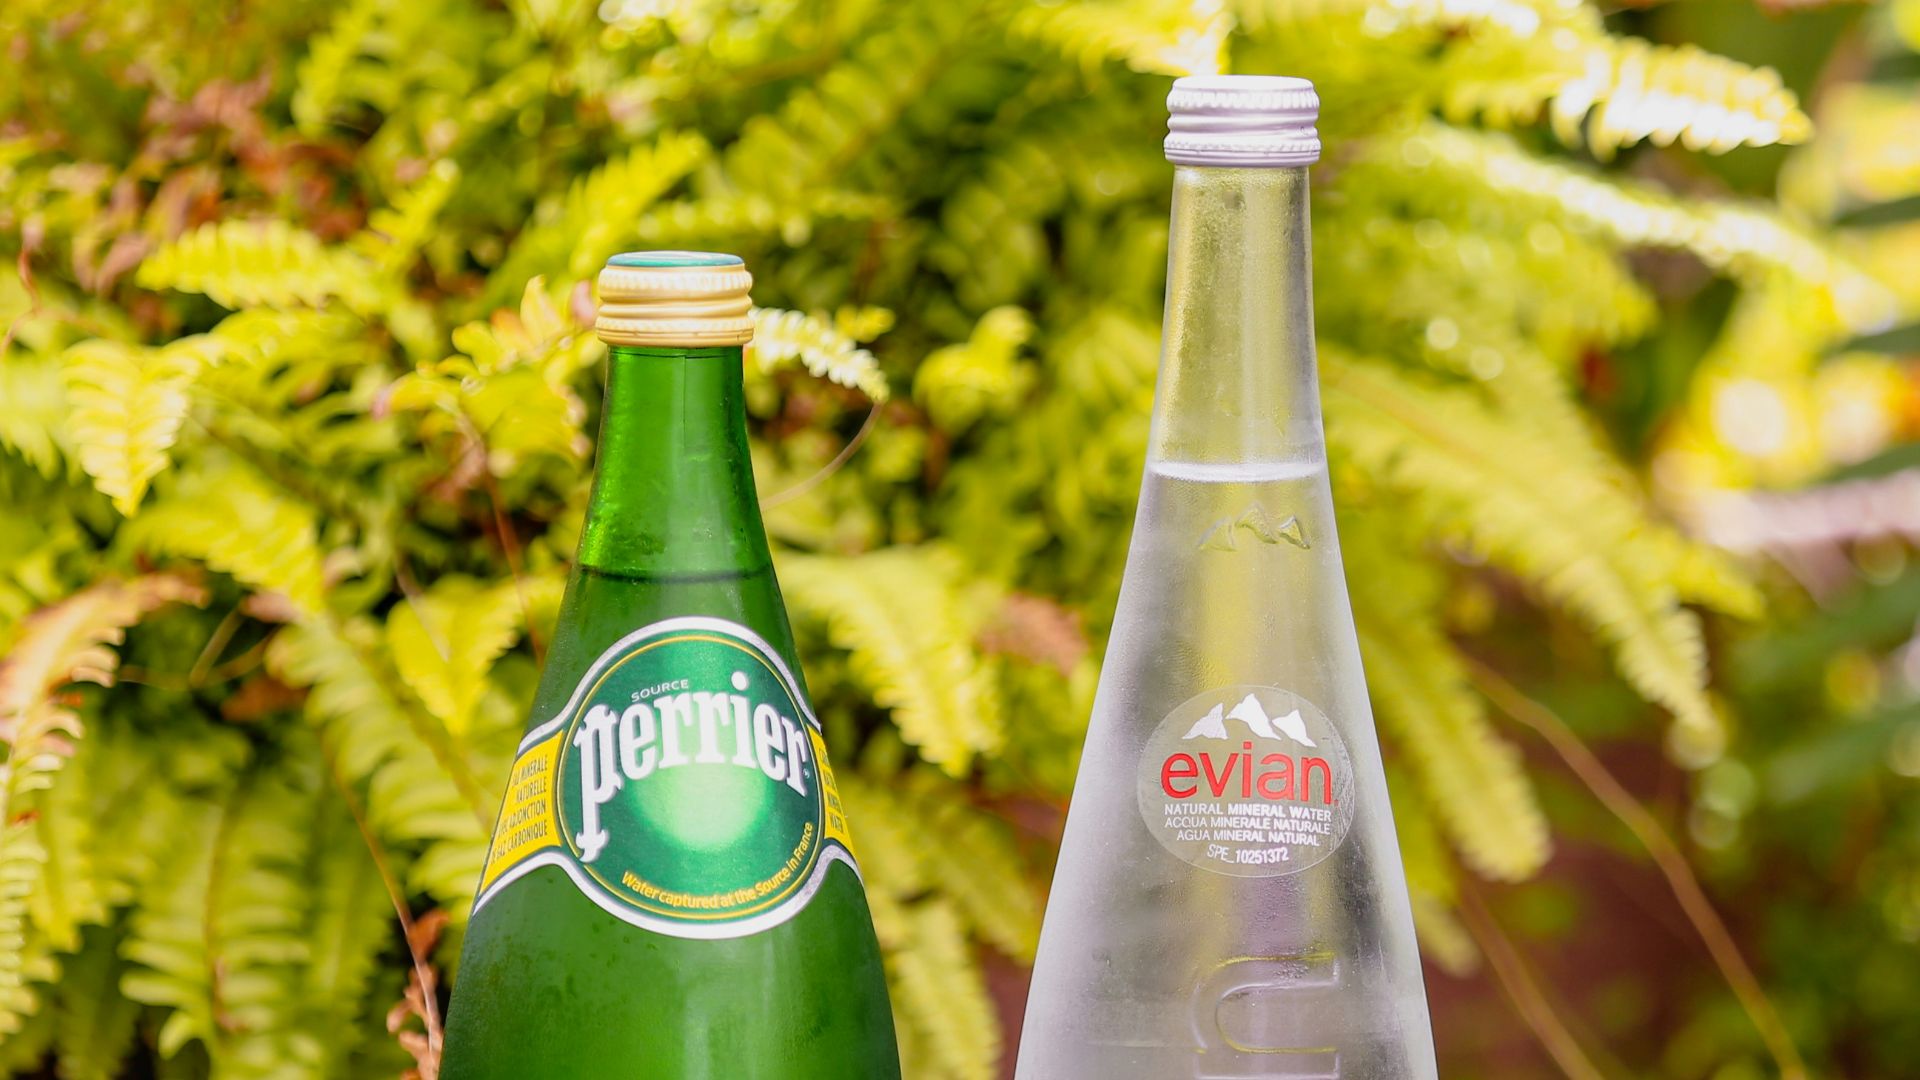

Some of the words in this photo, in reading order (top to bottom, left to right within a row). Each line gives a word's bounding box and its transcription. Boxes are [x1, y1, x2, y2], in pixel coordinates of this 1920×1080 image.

[631, 679, 689, 703] SOURCE
[1160, 741, 1332, 805] evian
[1164, 803, 1224, 816] NATURAL
[1227, 803, 1287, 818] MINERAL
[1289, 806, 1332, 822] WATER
[507, 818, 548, 852] CARBONIQUE
[1164, 816, 1207, 829] ACQUA
[1210, 816, 1271, 830] MINERALE
[1273, 819, 1331, 835] NATURALE
[1176, 829, 1211, 841] AGUA
[1213, 829, 1266, 843] MINERAL
[1268, 832, 1320, 847] NATURAL
[621, 871, 660, 899] Water
[658, 889, 719, 909] captured
[719, 893, 735, 907] at
[735, 887, 757, 904] the
[754, 867, 791, 897] Source
[785, 857, 798, 873] in
[793, 821, 814, 862] France
[1207, 843, 1290, 865] SPE_10251372
